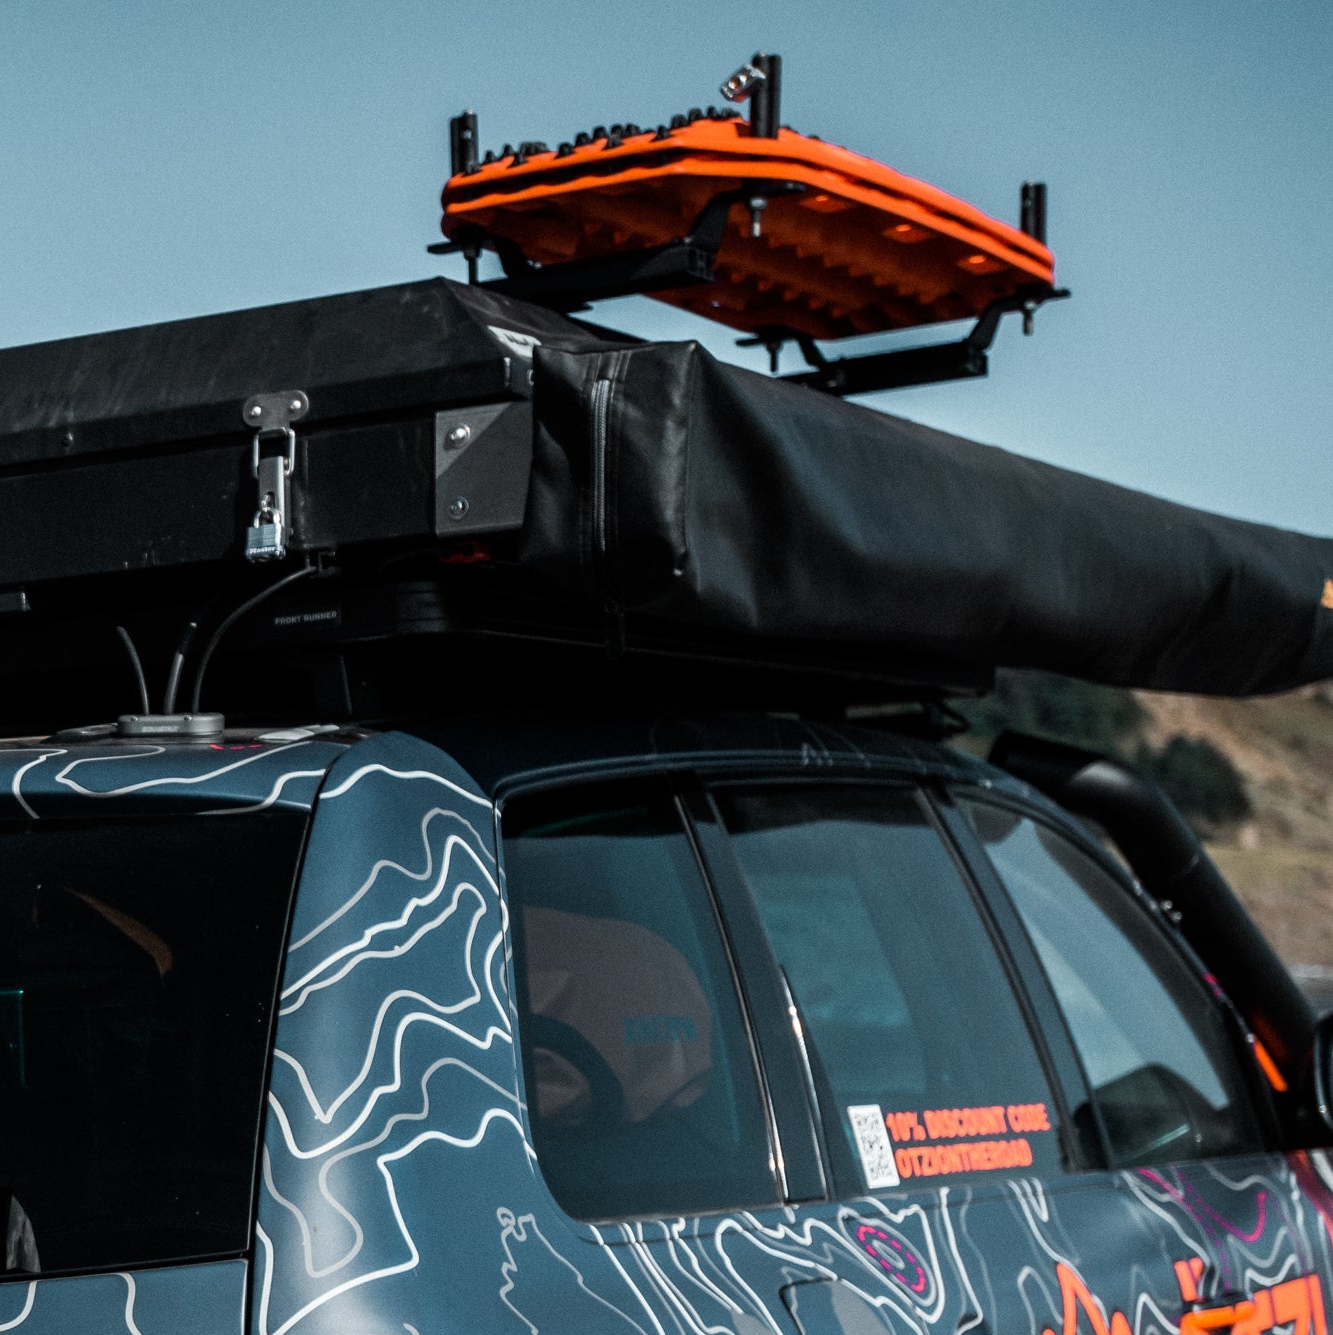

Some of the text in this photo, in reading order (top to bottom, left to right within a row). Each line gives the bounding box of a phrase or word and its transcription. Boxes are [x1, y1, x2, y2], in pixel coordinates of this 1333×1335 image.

[275, 611, 337, 625] FRONT RUNNER
[885, 1103, 1051, 1142] 10% DISCOUNT CODE
[894, 1138, 1033, 1179] OTZIONTHEROAD
